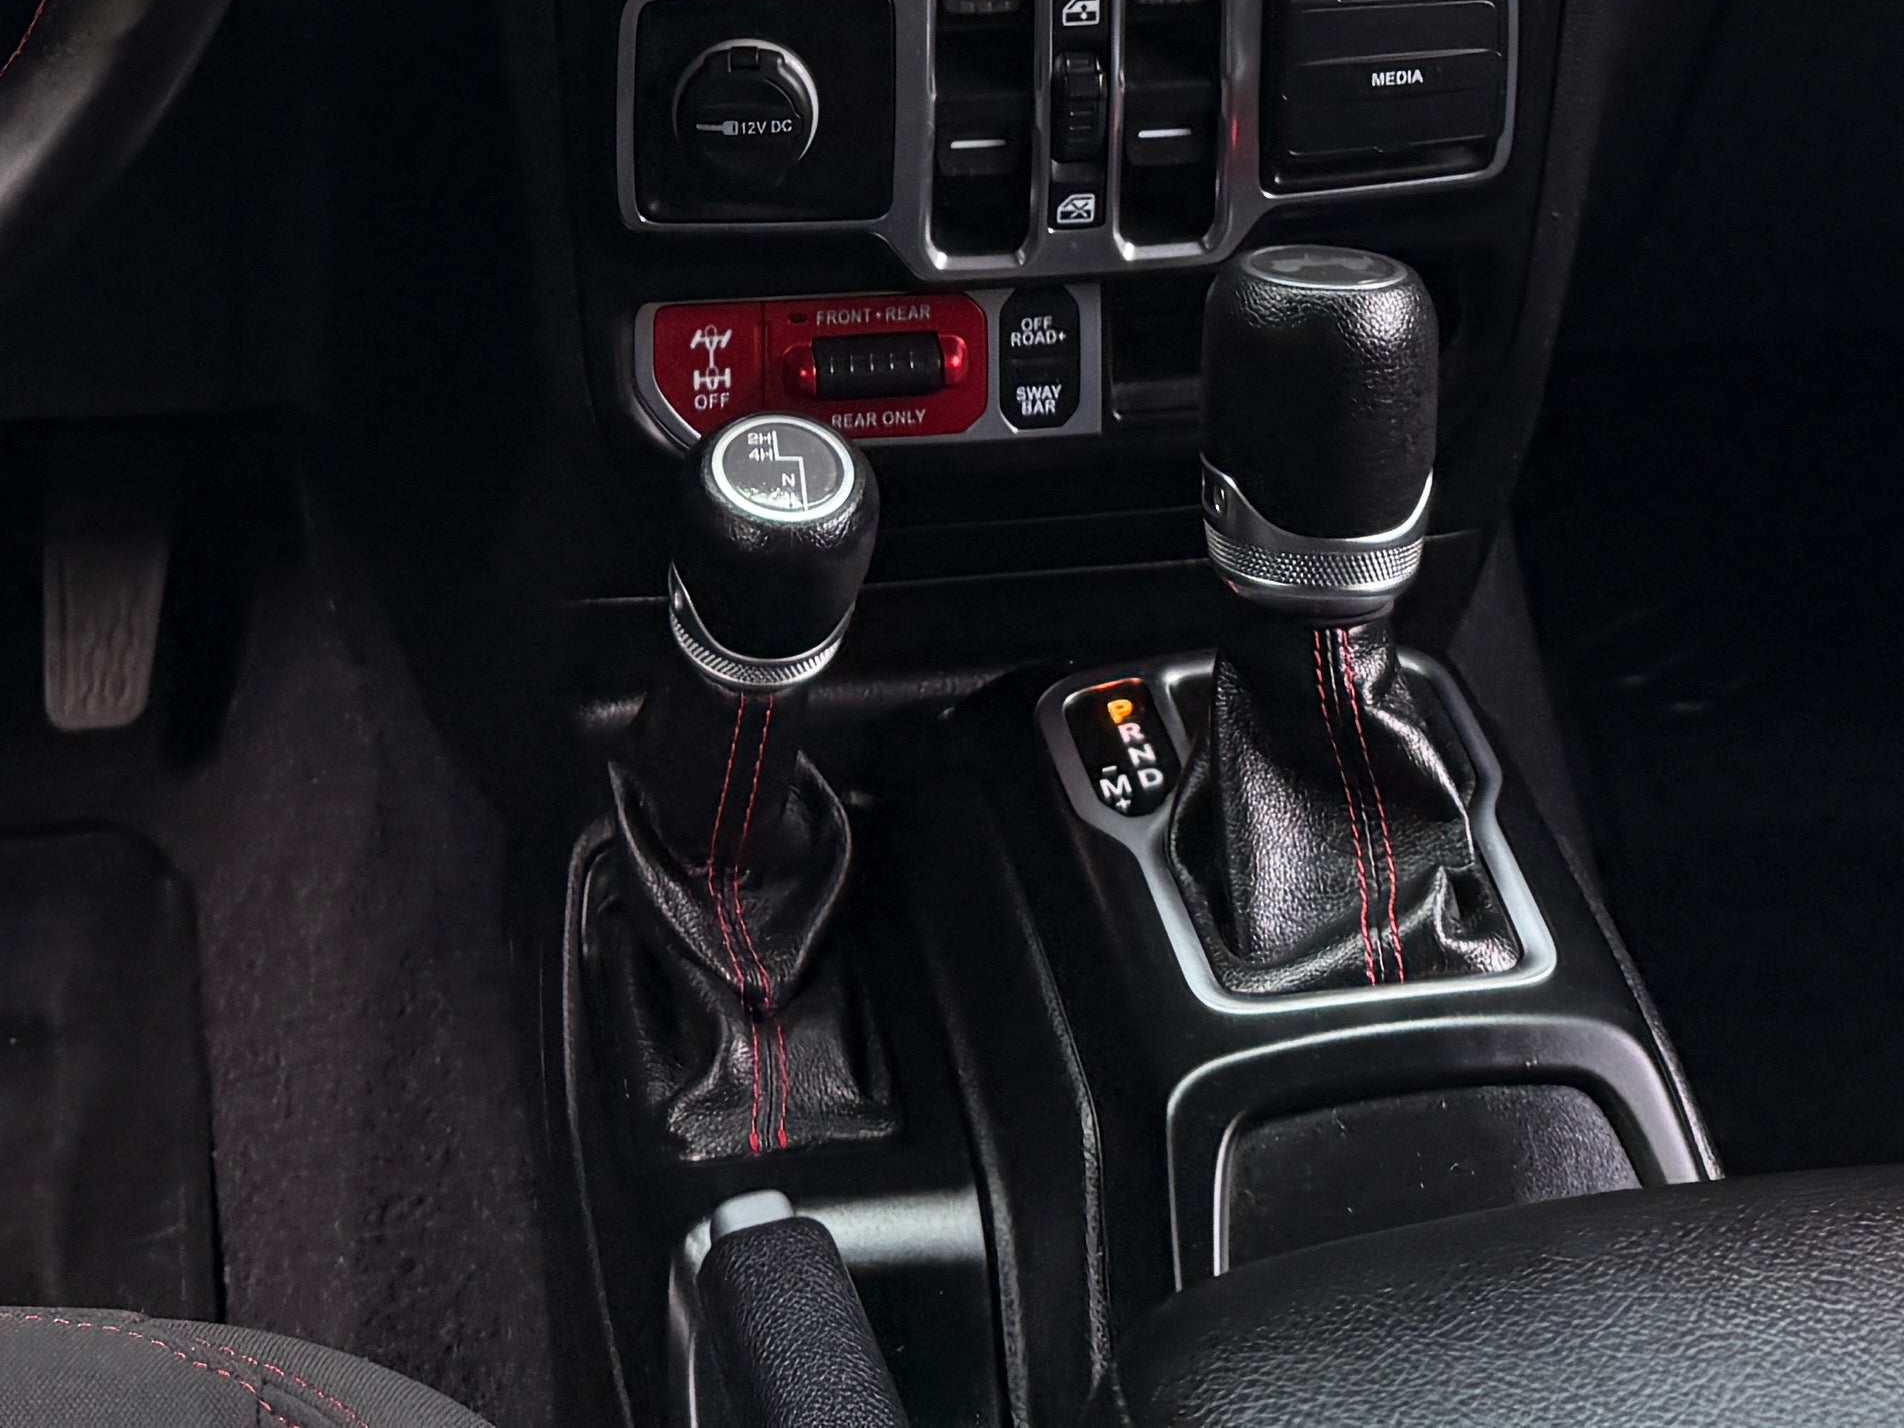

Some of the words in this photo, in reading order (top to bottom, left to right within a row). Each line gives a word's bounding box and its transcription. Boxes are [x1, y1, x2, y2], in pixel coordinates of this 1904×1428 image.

[1370, 69, 1424, 87] MEDIA
[739, 120, 768, 135] 12V
[771, 119, 793, 133] DC
[815, 307, 871, 326] FRONT
[885, 304, 932, 322] REAR
[1020, 316, 1054, 334] OFF
[693, 393, 731, 411] OFF
[1015, 383, 1063, 403] SWAY
[1020, 398, 1057, 416] BAR
[831, 412, 878, 430] REAR
[881, 408, 927, 427] ONLY
[747, 431, 772, 446] 2H
[748, 447, 774, 462] 4H
[781, 472, 796, 488] N
[1107, 698, 1134, 725] P
[1117, 722, 1145, 744] R
[1127, 743, 1157, 767] N
[1099, 773, 1133, 799] M
[1137, 767, 1164, 789] D
